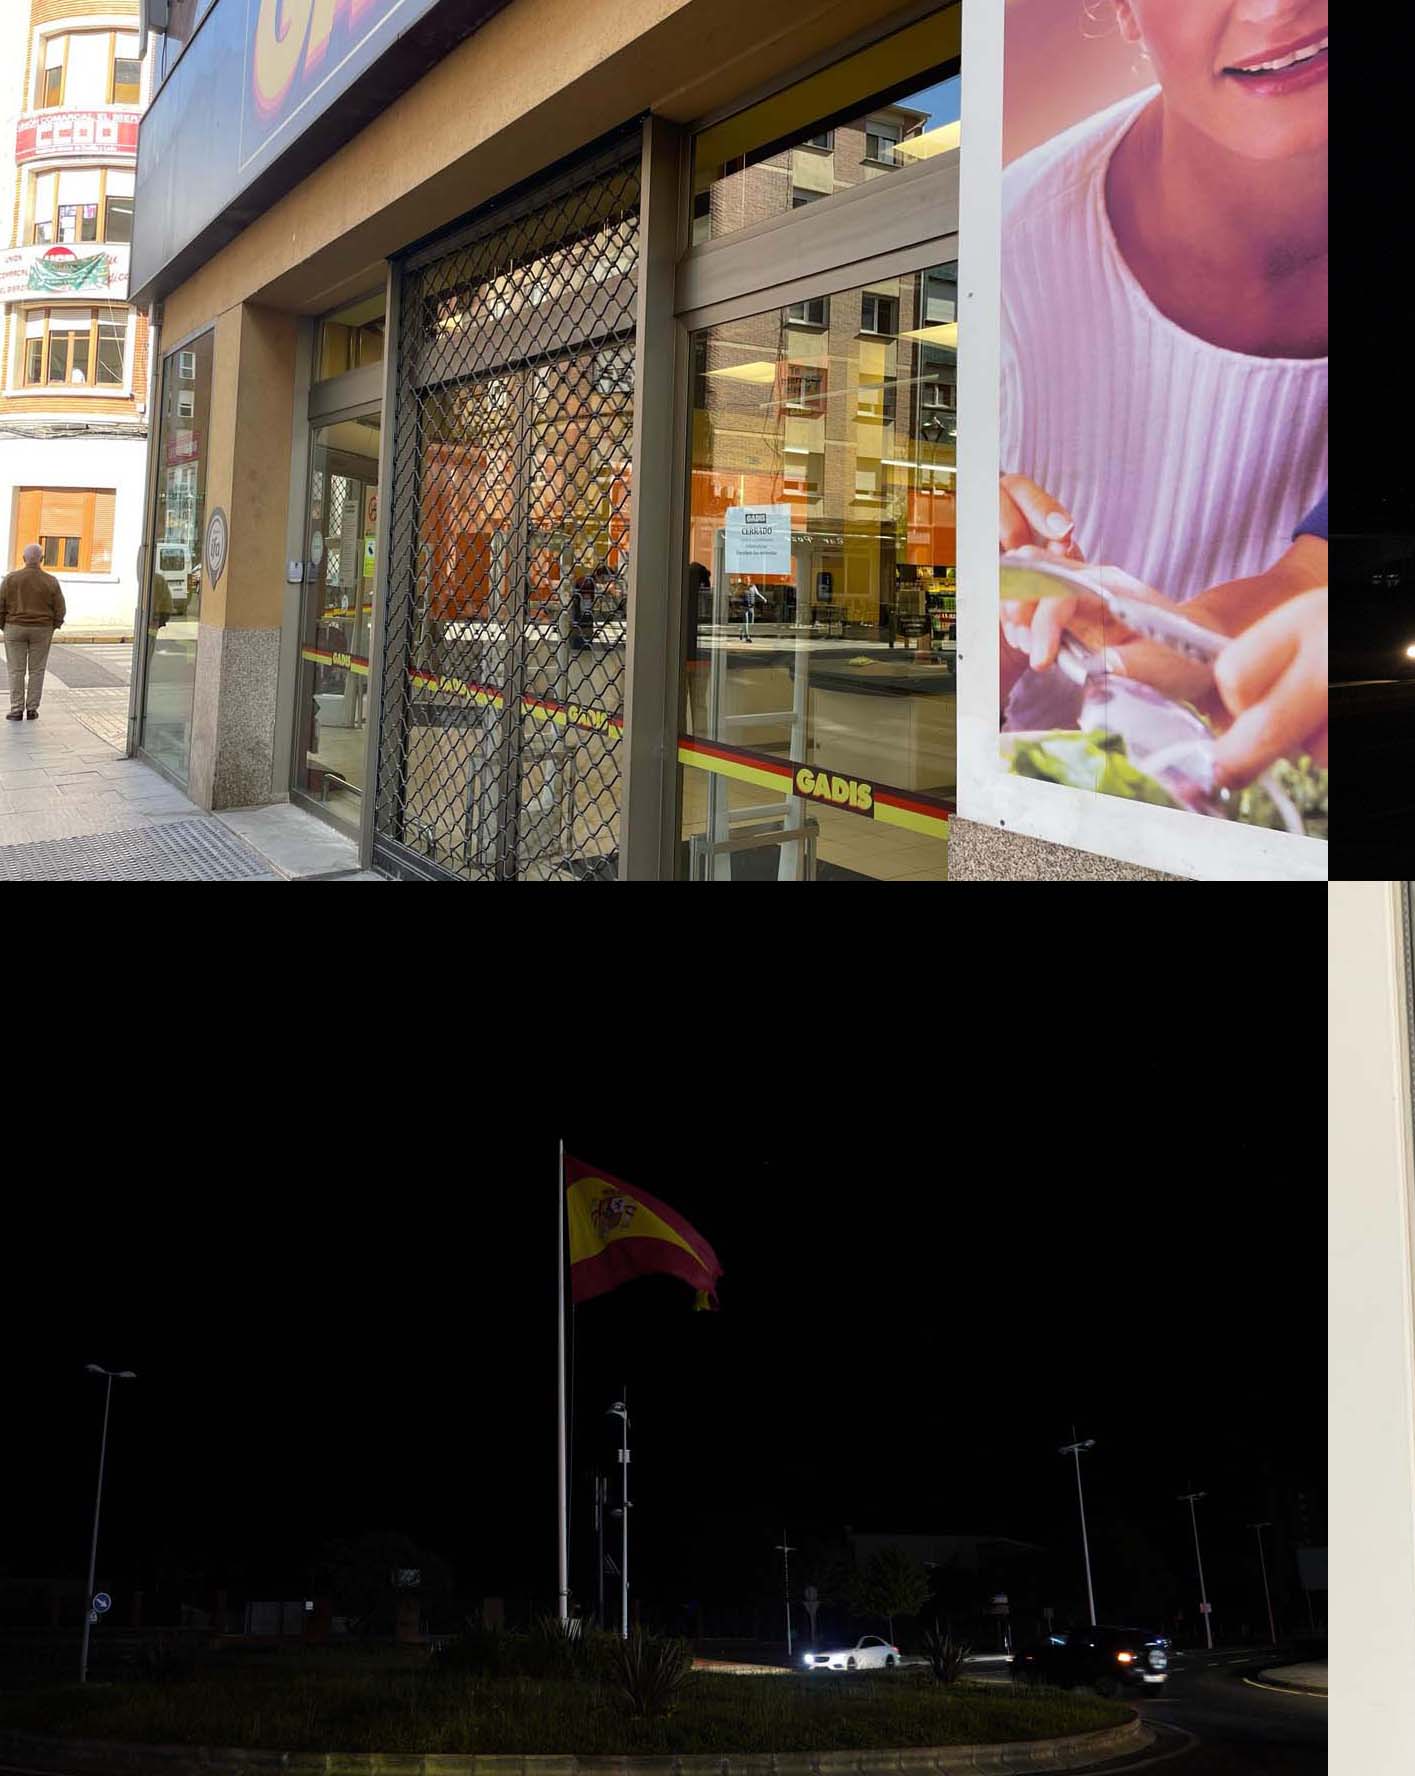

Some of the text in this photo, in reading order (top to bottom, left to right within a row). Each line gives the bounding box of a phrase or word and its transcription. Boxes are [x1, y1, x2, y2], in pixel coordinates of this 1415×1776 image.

[36, 121, 118, 147] CCOO
[741, 527, 773, 537] CERRADO
[796, 768, 873, 810] GADIS
